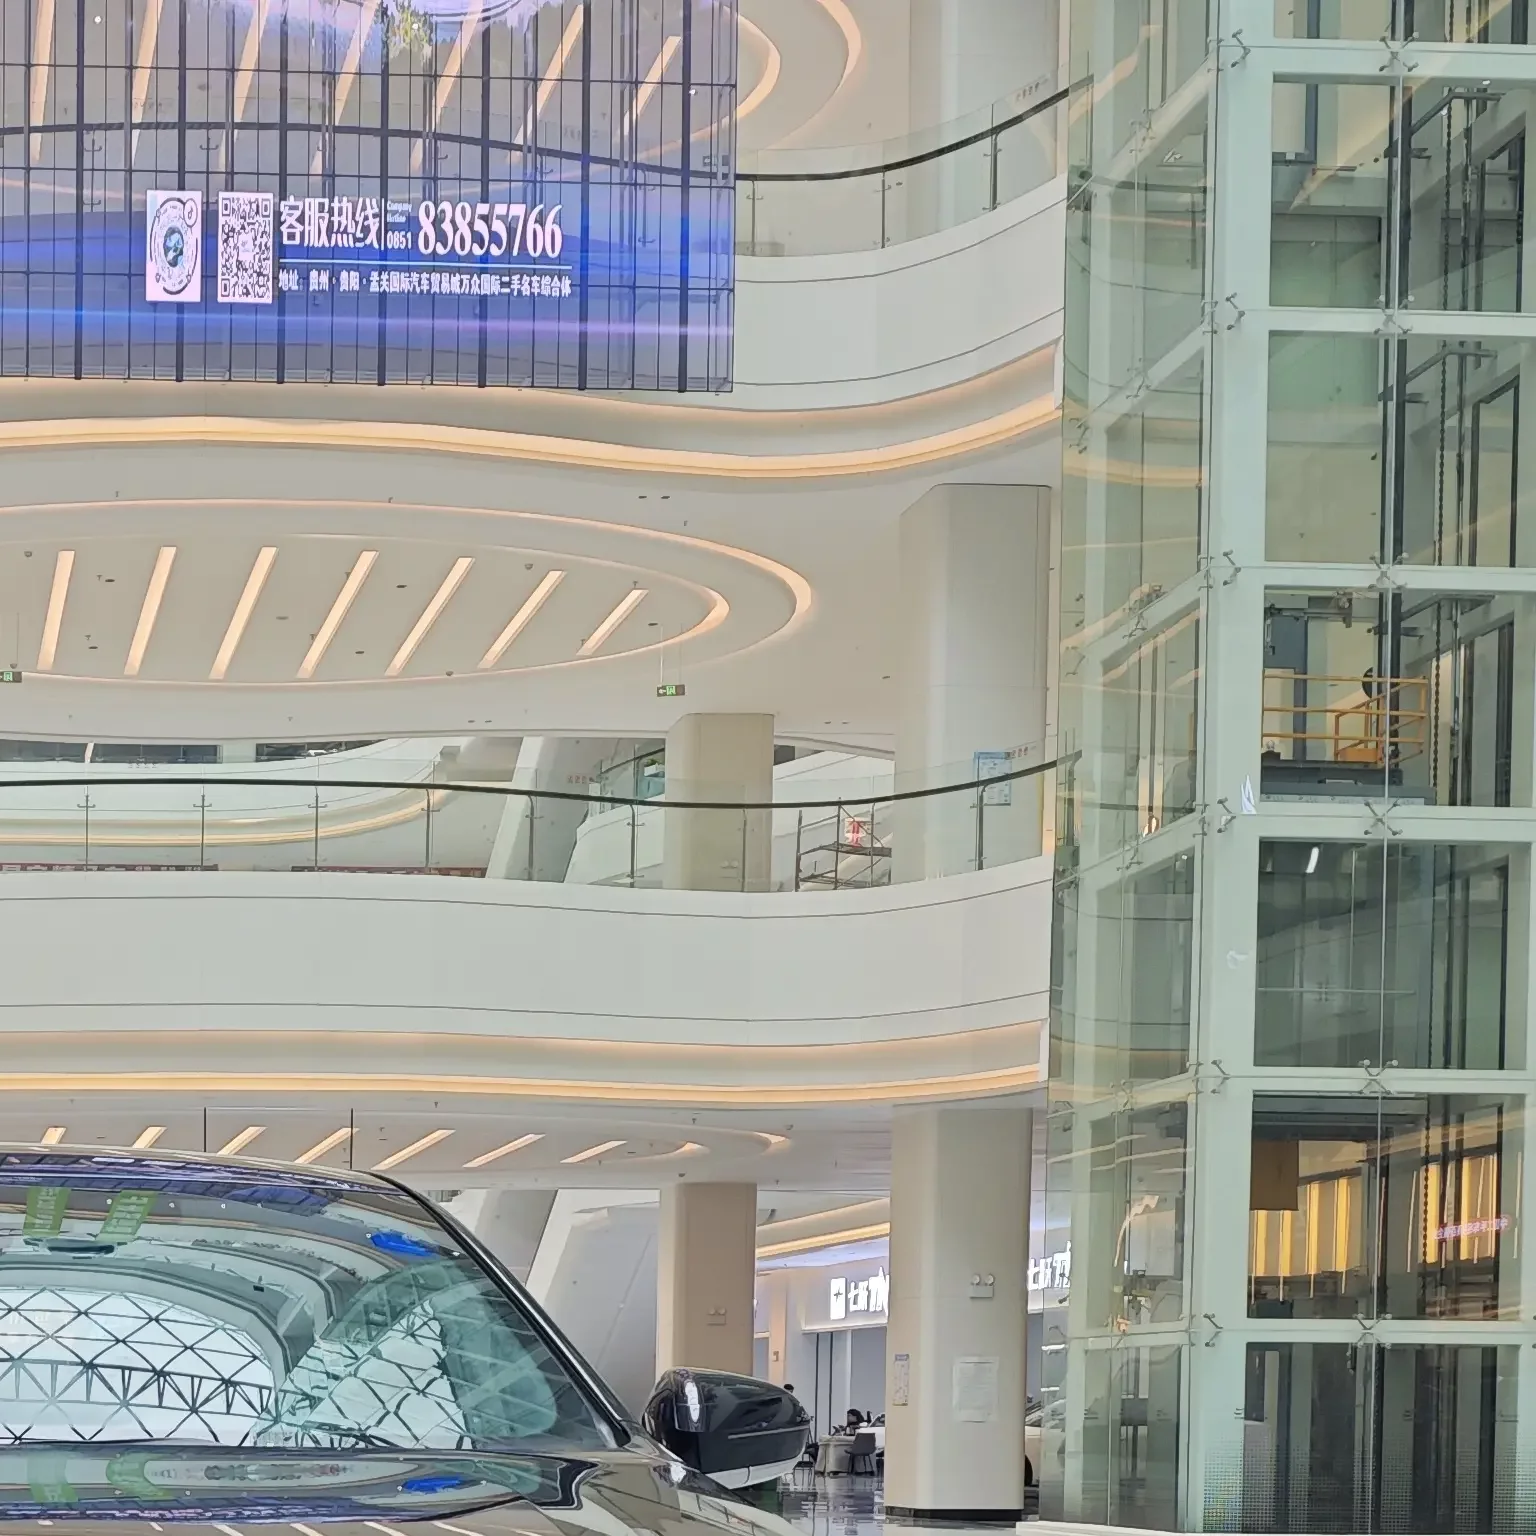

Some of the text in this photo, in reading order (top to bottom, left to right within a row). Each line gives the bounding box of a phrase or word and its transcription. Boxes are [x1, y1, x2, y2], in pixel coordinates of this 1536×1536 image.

[279, 195, 380, 249] 客服热线
[386, 200, 563, 258] 0851 83855766
